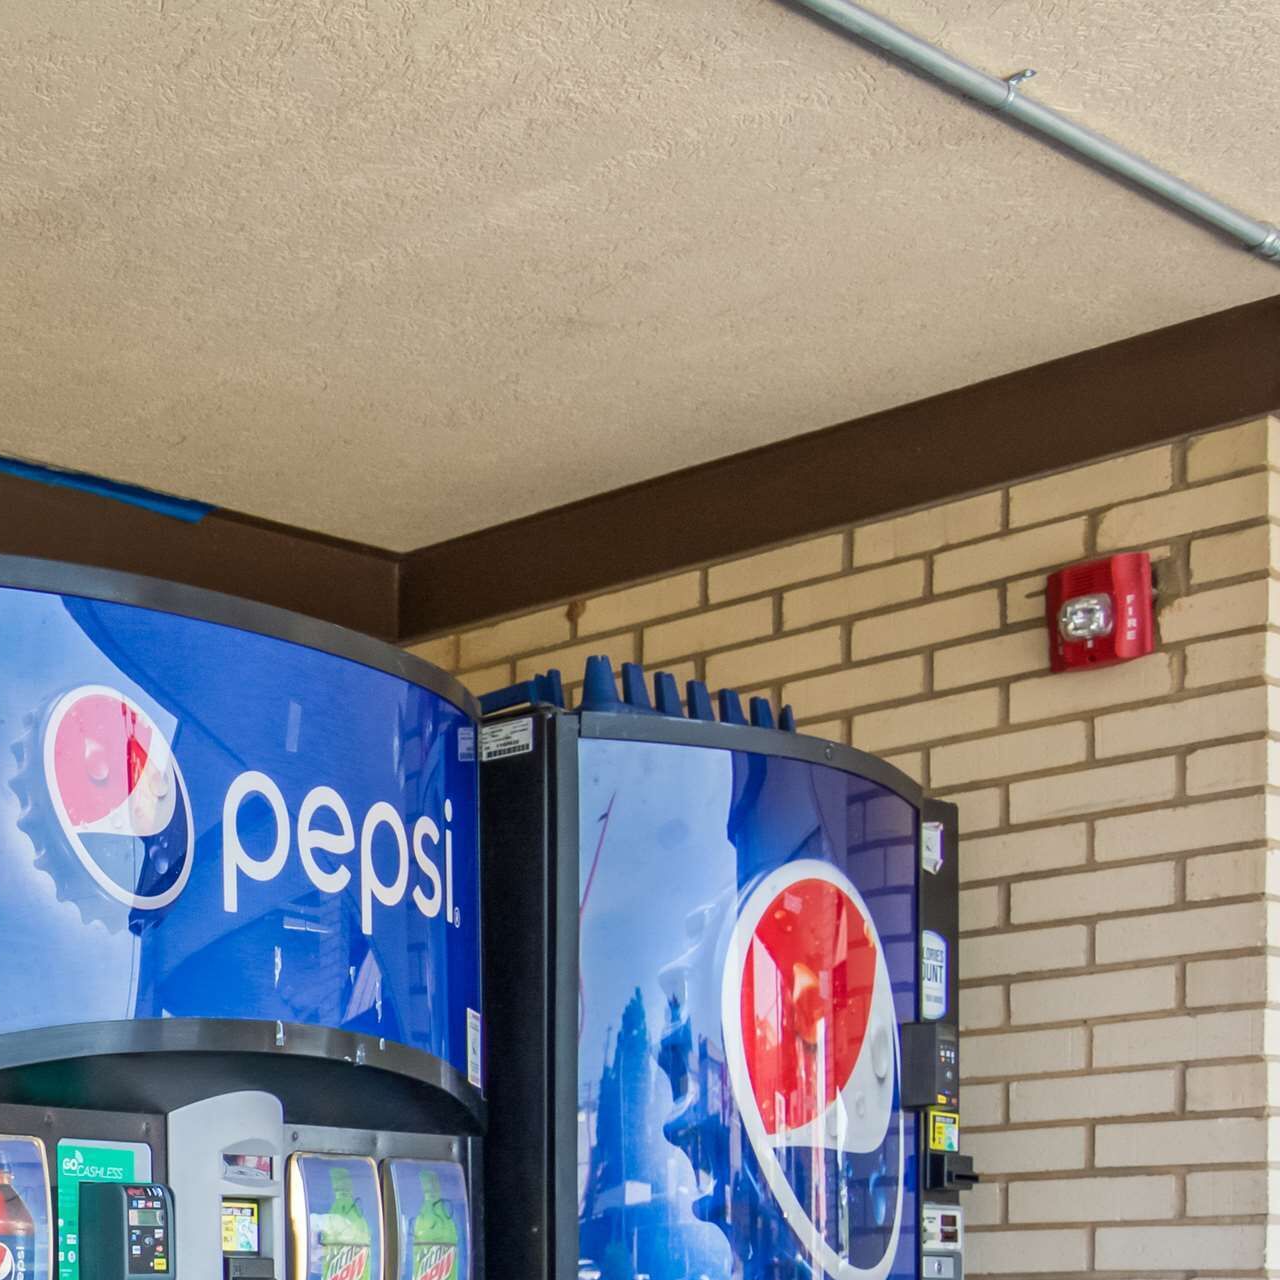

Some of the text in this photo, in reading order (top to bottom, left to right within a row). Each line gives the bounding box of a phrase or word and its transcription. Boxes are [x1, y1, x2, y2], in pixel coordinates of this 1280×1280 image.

[223, 771, 454, 935] pepsi
[63, 1158, 123, 1179] GO CASHLESS
